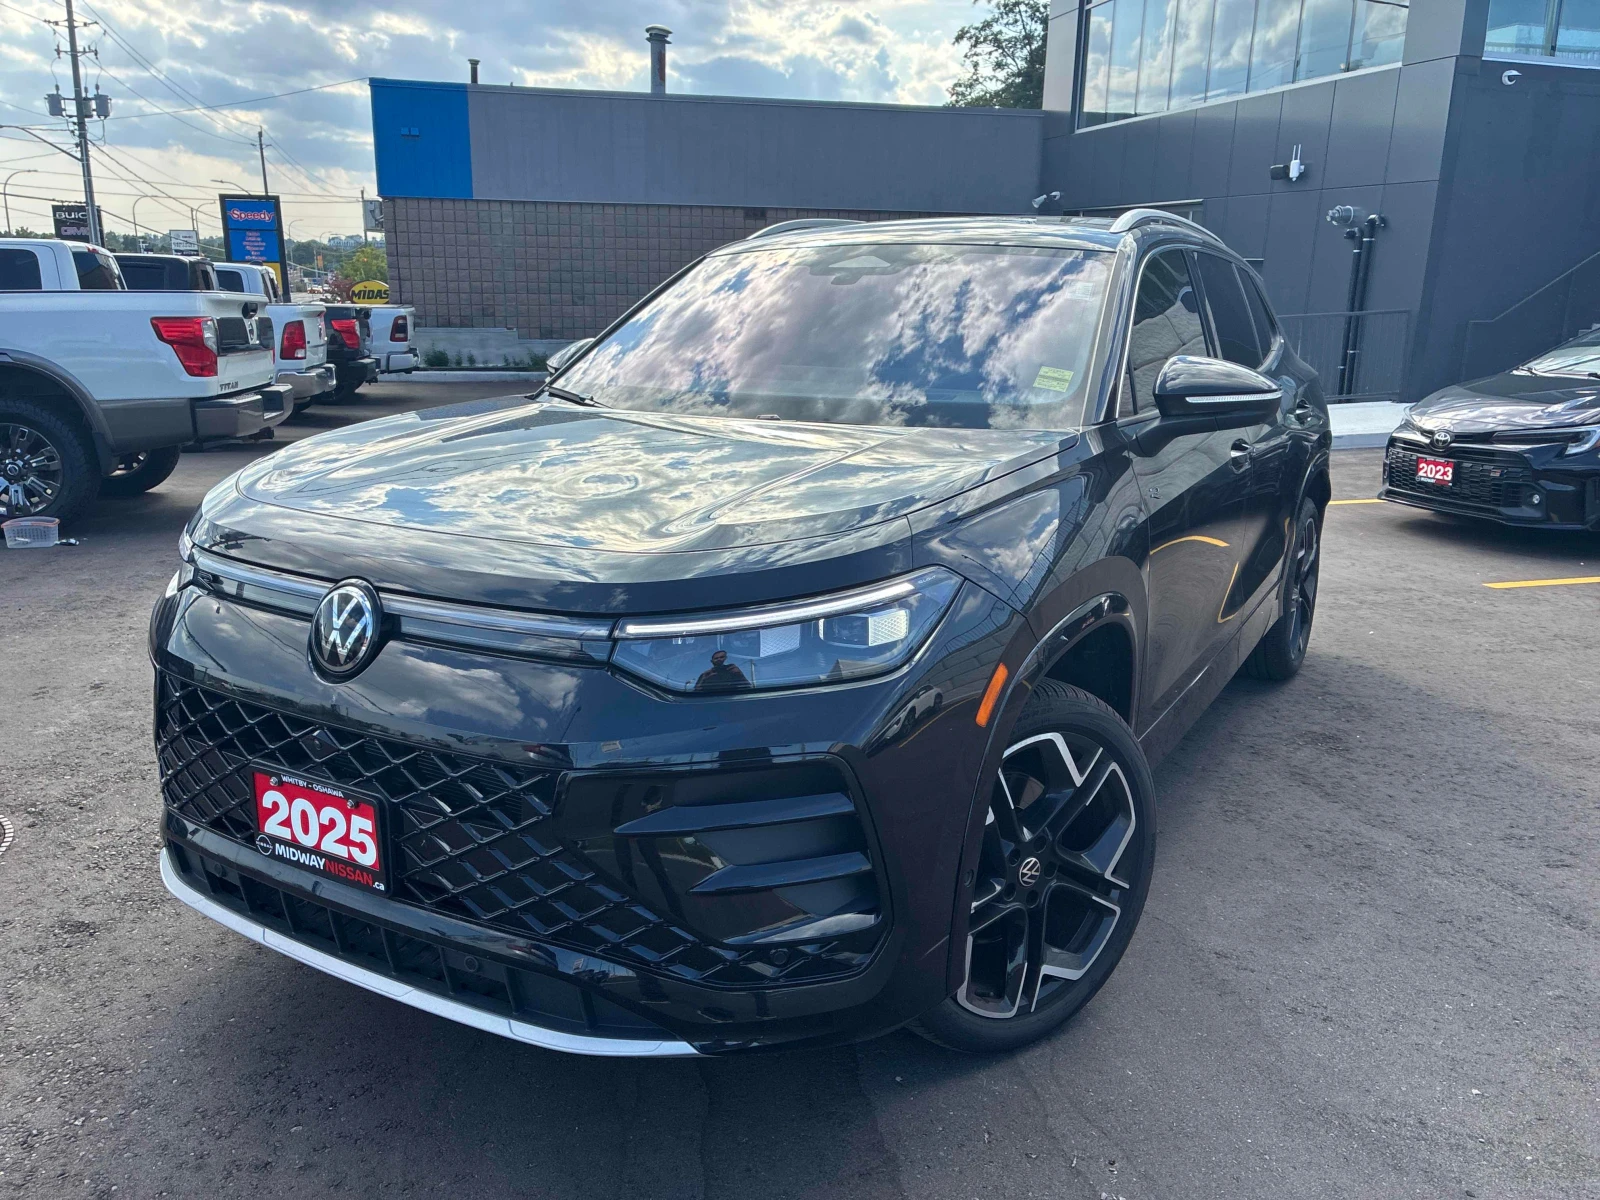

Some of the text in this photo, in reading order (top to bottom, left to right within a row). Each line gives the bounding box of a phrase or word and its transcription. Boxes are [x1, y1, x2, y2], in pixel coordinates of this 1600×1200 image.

[55, 211, 88, 219] BUIC
[229, 208, 273, 222] Speedy
[60, 226, 89, 236] GM
[351, 289, 389, 300] MIDAS
[219, 381, 239, 391] TITAN
[1418, 463, 1453, 481] 2023
[281, 775, 307, 788] WHITBY
[312, 783, 345, 798] OSHAWA
[262, 790, 377, 866] 2025
